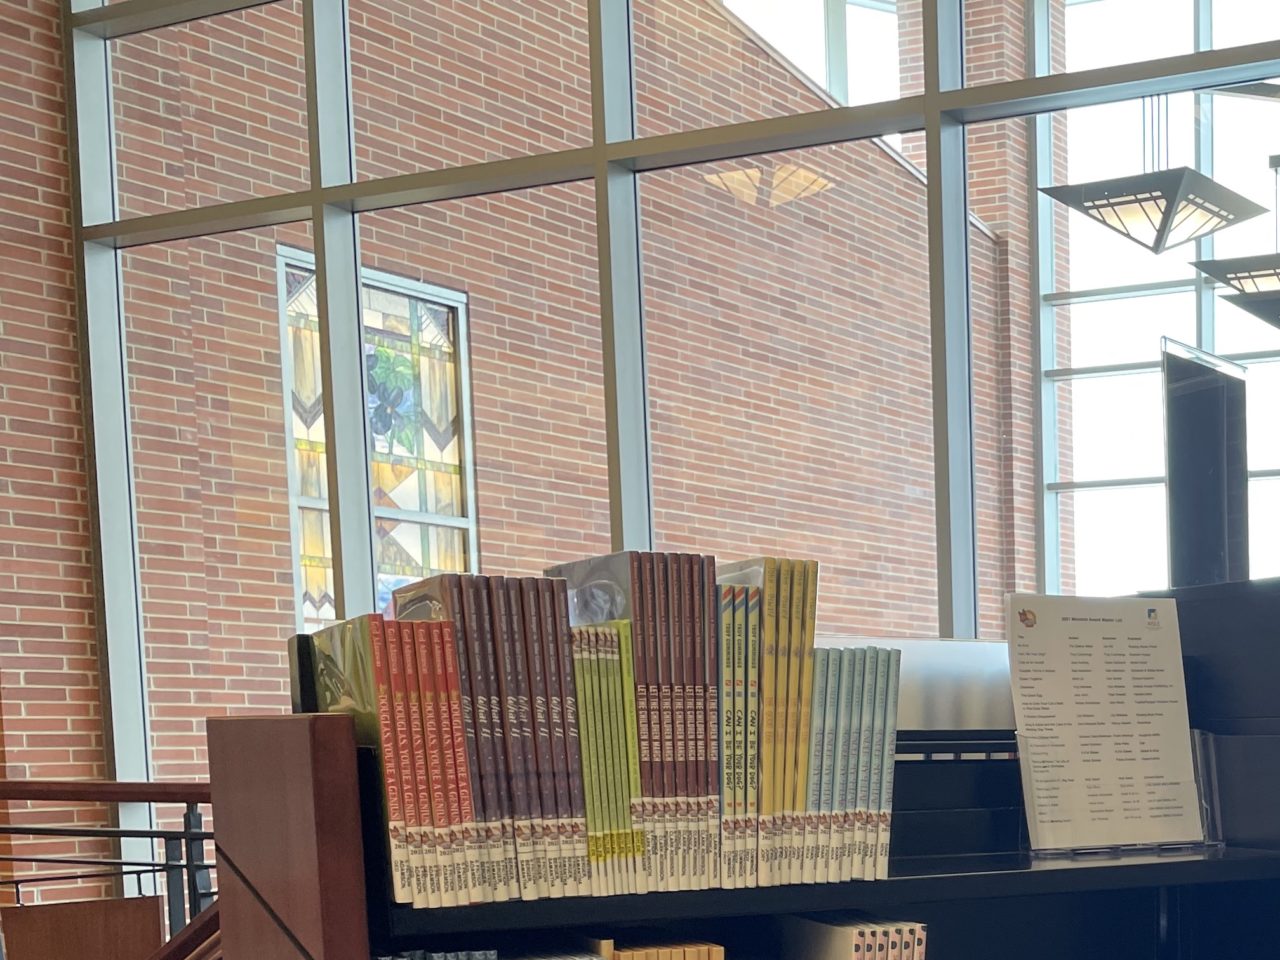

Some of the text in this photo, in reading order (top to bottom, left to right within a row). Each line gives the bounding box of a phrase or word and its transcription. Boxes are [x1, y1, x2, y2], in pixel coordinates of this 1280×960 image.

[726, 741, 731, 751] BE
[750, 741, 755, 751] BE
[725, 754, 733, 770] YOUR
[749, 754, 757, 770] YOUR
